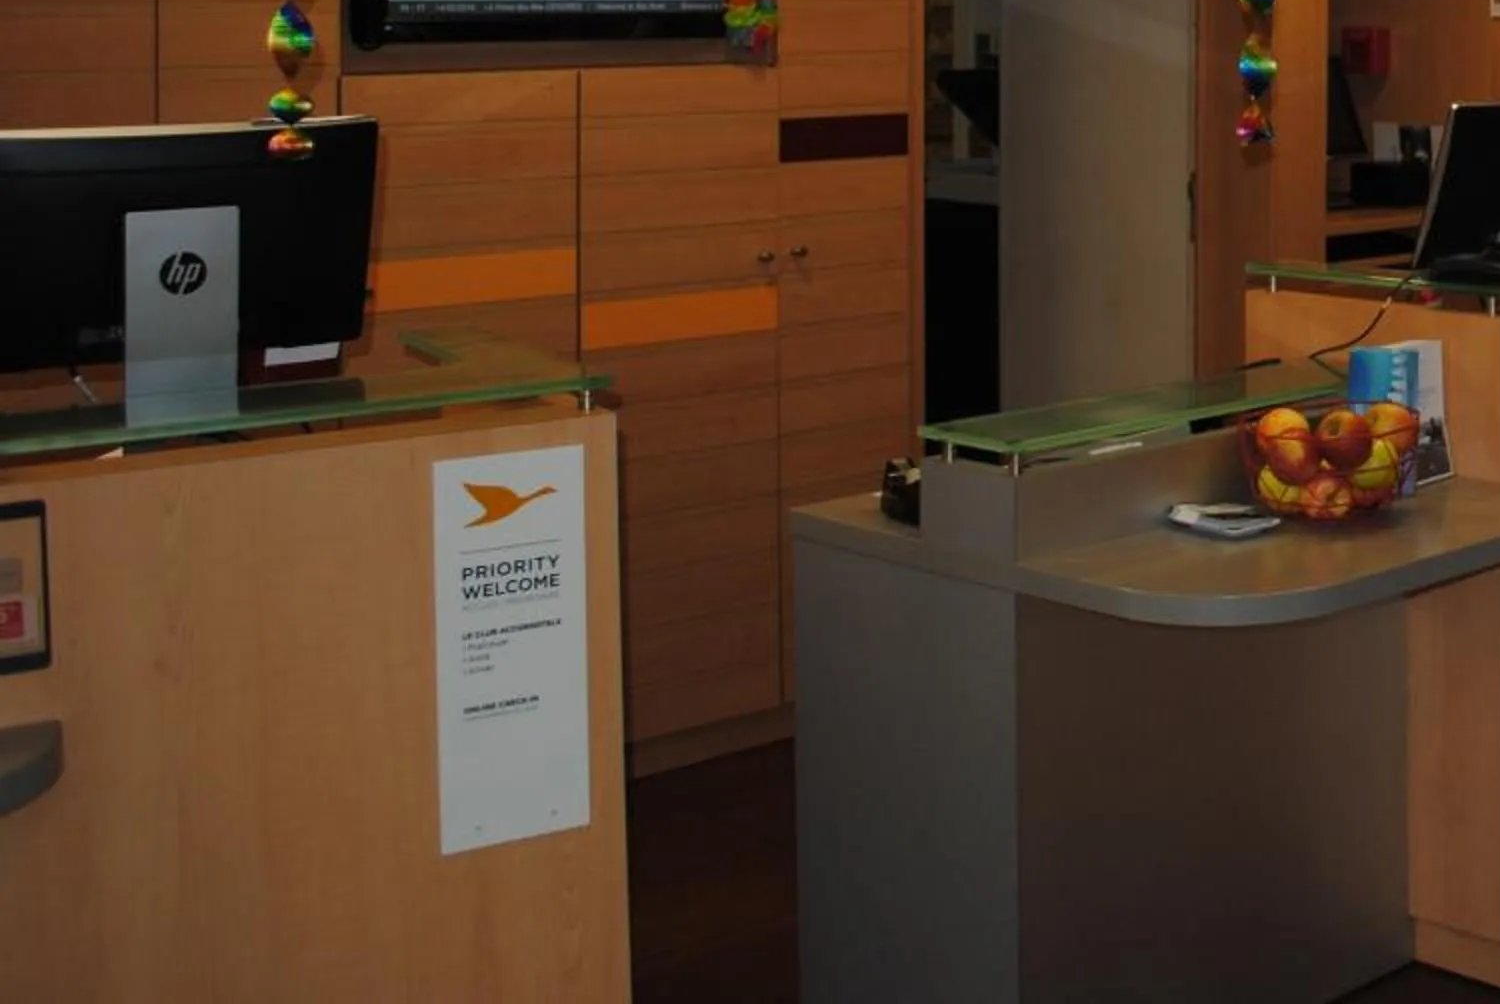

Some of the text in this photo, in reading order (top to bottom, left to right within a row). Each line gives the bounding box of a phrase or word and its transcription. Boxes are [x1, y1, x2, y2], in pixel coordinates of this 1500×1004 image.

[163, 250, 204, 296] hp
[462, 554, 560, 582] PRIORITY
[462, 573, 561, 600] WELCOME
